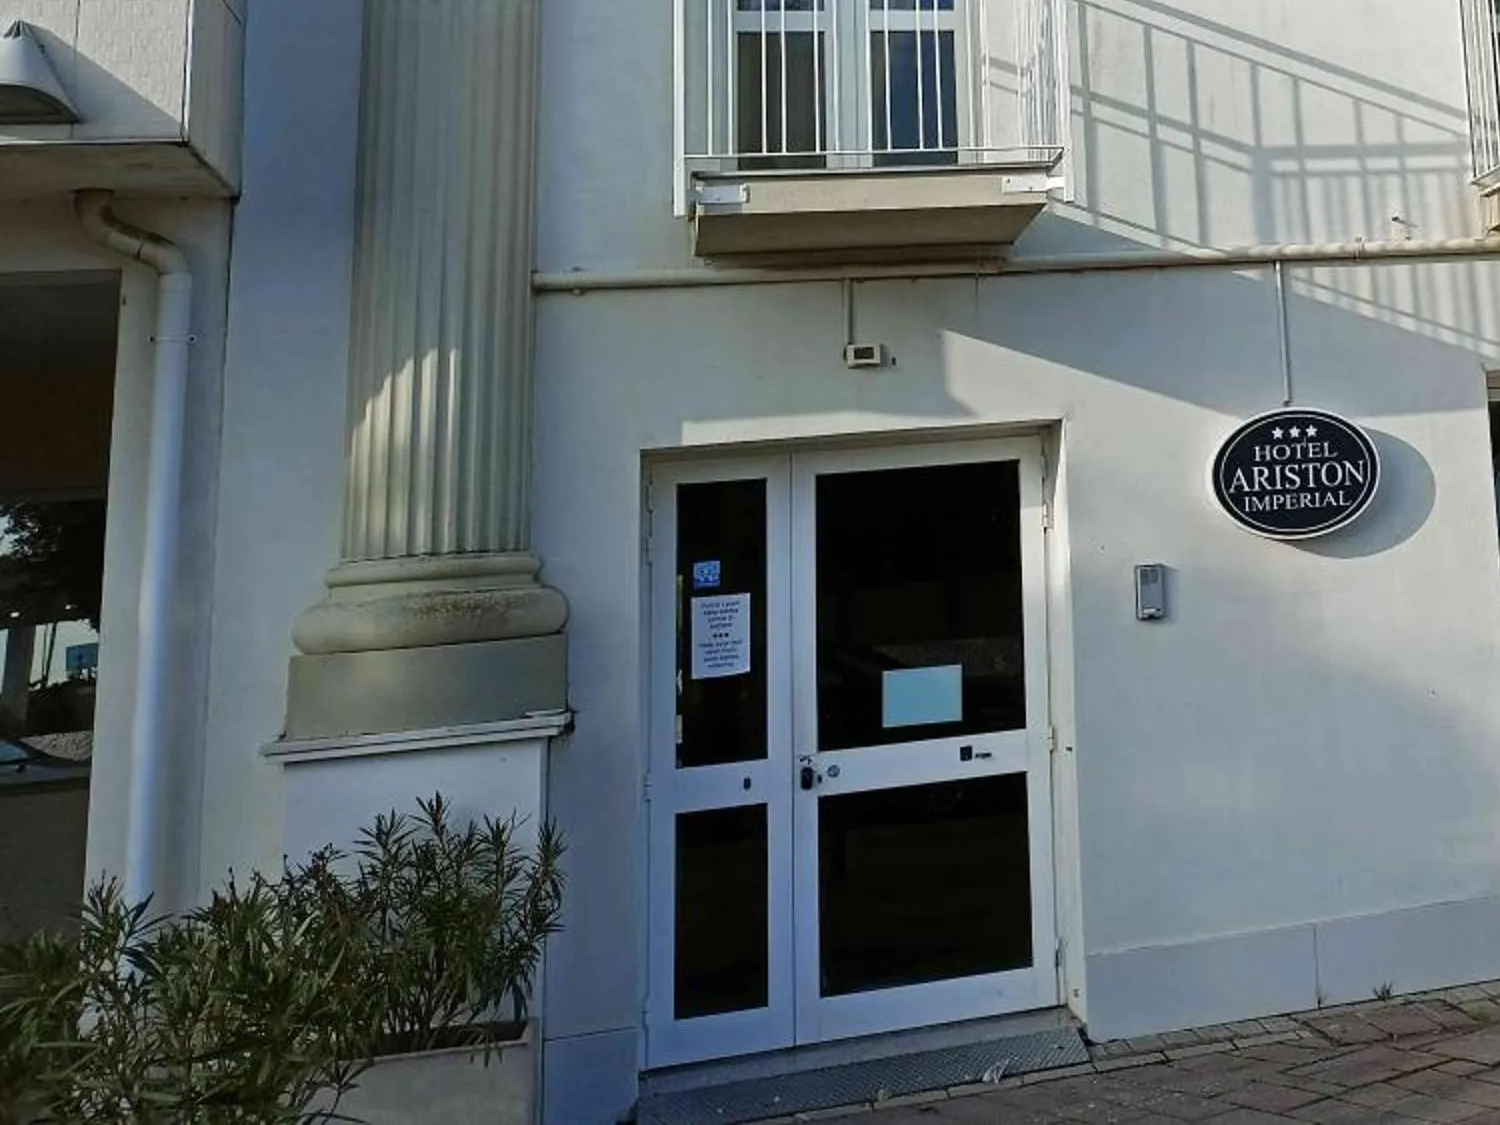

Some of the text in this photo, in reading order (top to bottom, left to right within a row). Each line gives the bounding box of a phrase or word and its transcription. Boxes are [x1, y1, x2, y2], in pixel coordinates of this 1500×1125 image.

[1254, 441, 1338, 462] HOTEL
[1229, 460, 1365, 494] ARISTON
[1244, 490, 1352, 512] IMPERIAL
